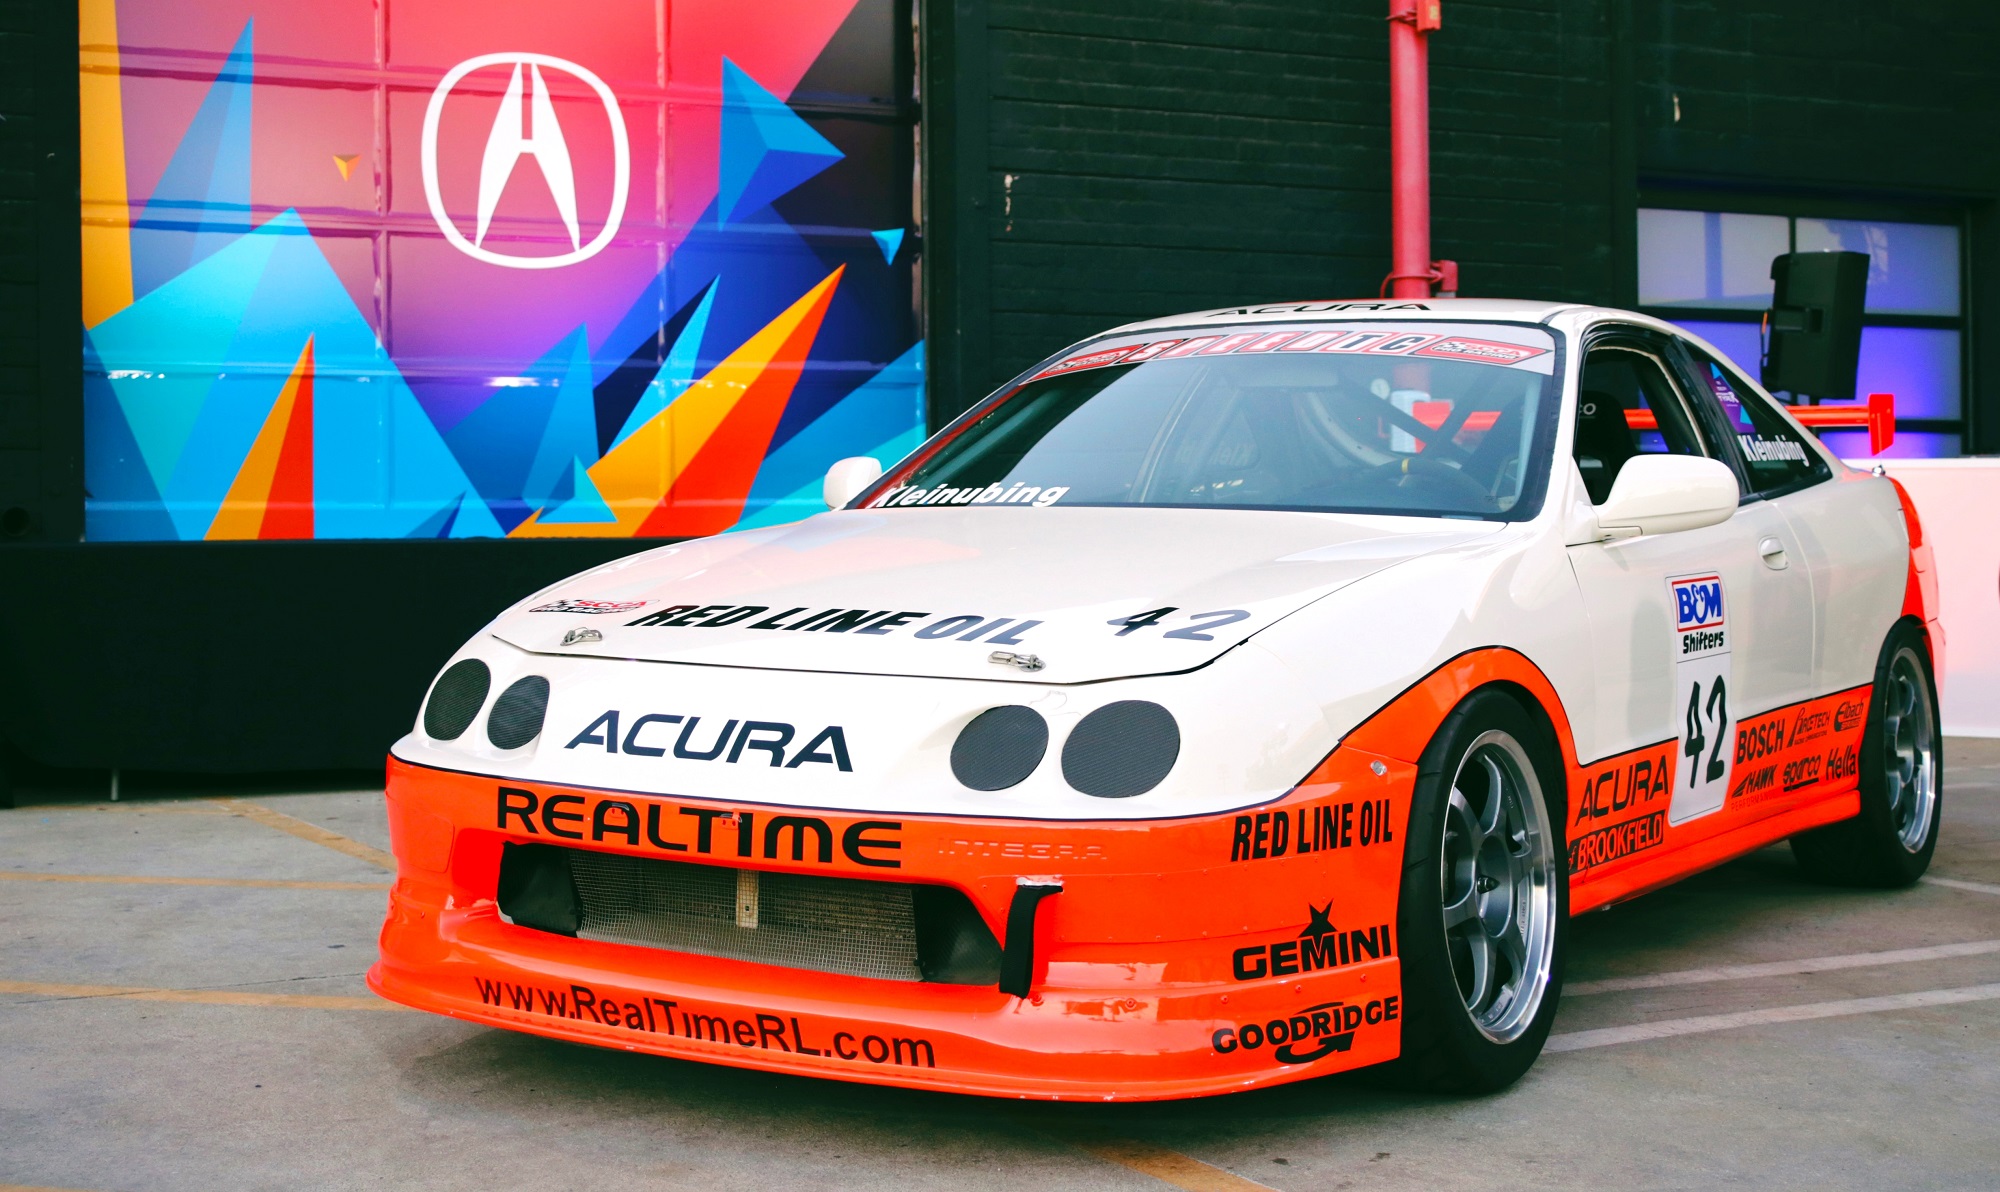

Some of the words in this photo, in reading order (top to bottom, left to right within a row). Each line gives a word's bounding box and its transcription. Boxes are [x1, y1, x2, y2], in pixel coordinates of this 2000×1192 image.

[1205, 303, 1431, 318] ACURA
[1125, 333, 1340, 361] SPEED
[1737, 433, 1810, 468] Kleinubing
[866, 482, 1071, 507] Kleinubing
[1675, 583, 1722, 624] B&M
[622, 605, 766, 628] RED
[747, 607, 932, 636] LINE
[915, 614, 1046, 645] OIL
[1106, 607, 1252, 641] 42
[1682, 631, 1724, 654] Shifters
[564, 710, 854, 772] ACURA
[1685, 675, 1728, 789] 42
[1736, 718, 1786, 765] BOSCH
[1745, 764, 1778, 795] HAWK
[1783, 754, 1822, 792] sparco
[1826, 744, 1857, 781] Hella
[1574, 755, 1669, 828] ACURA
[497, 786, 903, 869] REALTIME
[1230, 811, 1289, 862] RED
[1297, 802, 1353, 853] LINE
[1359, 798, 1393, 846] OIL
[1577, 813, 1664, 871] BROOKFIELD
[938, 838, 1108, 860] INTEGRA
[1232, 924, 1392, 981] GEMINI
[474, 976, 936, 1069] www.RealTimeRL.com
[1211, 995, 1400, 1054] GOODRIDGE
